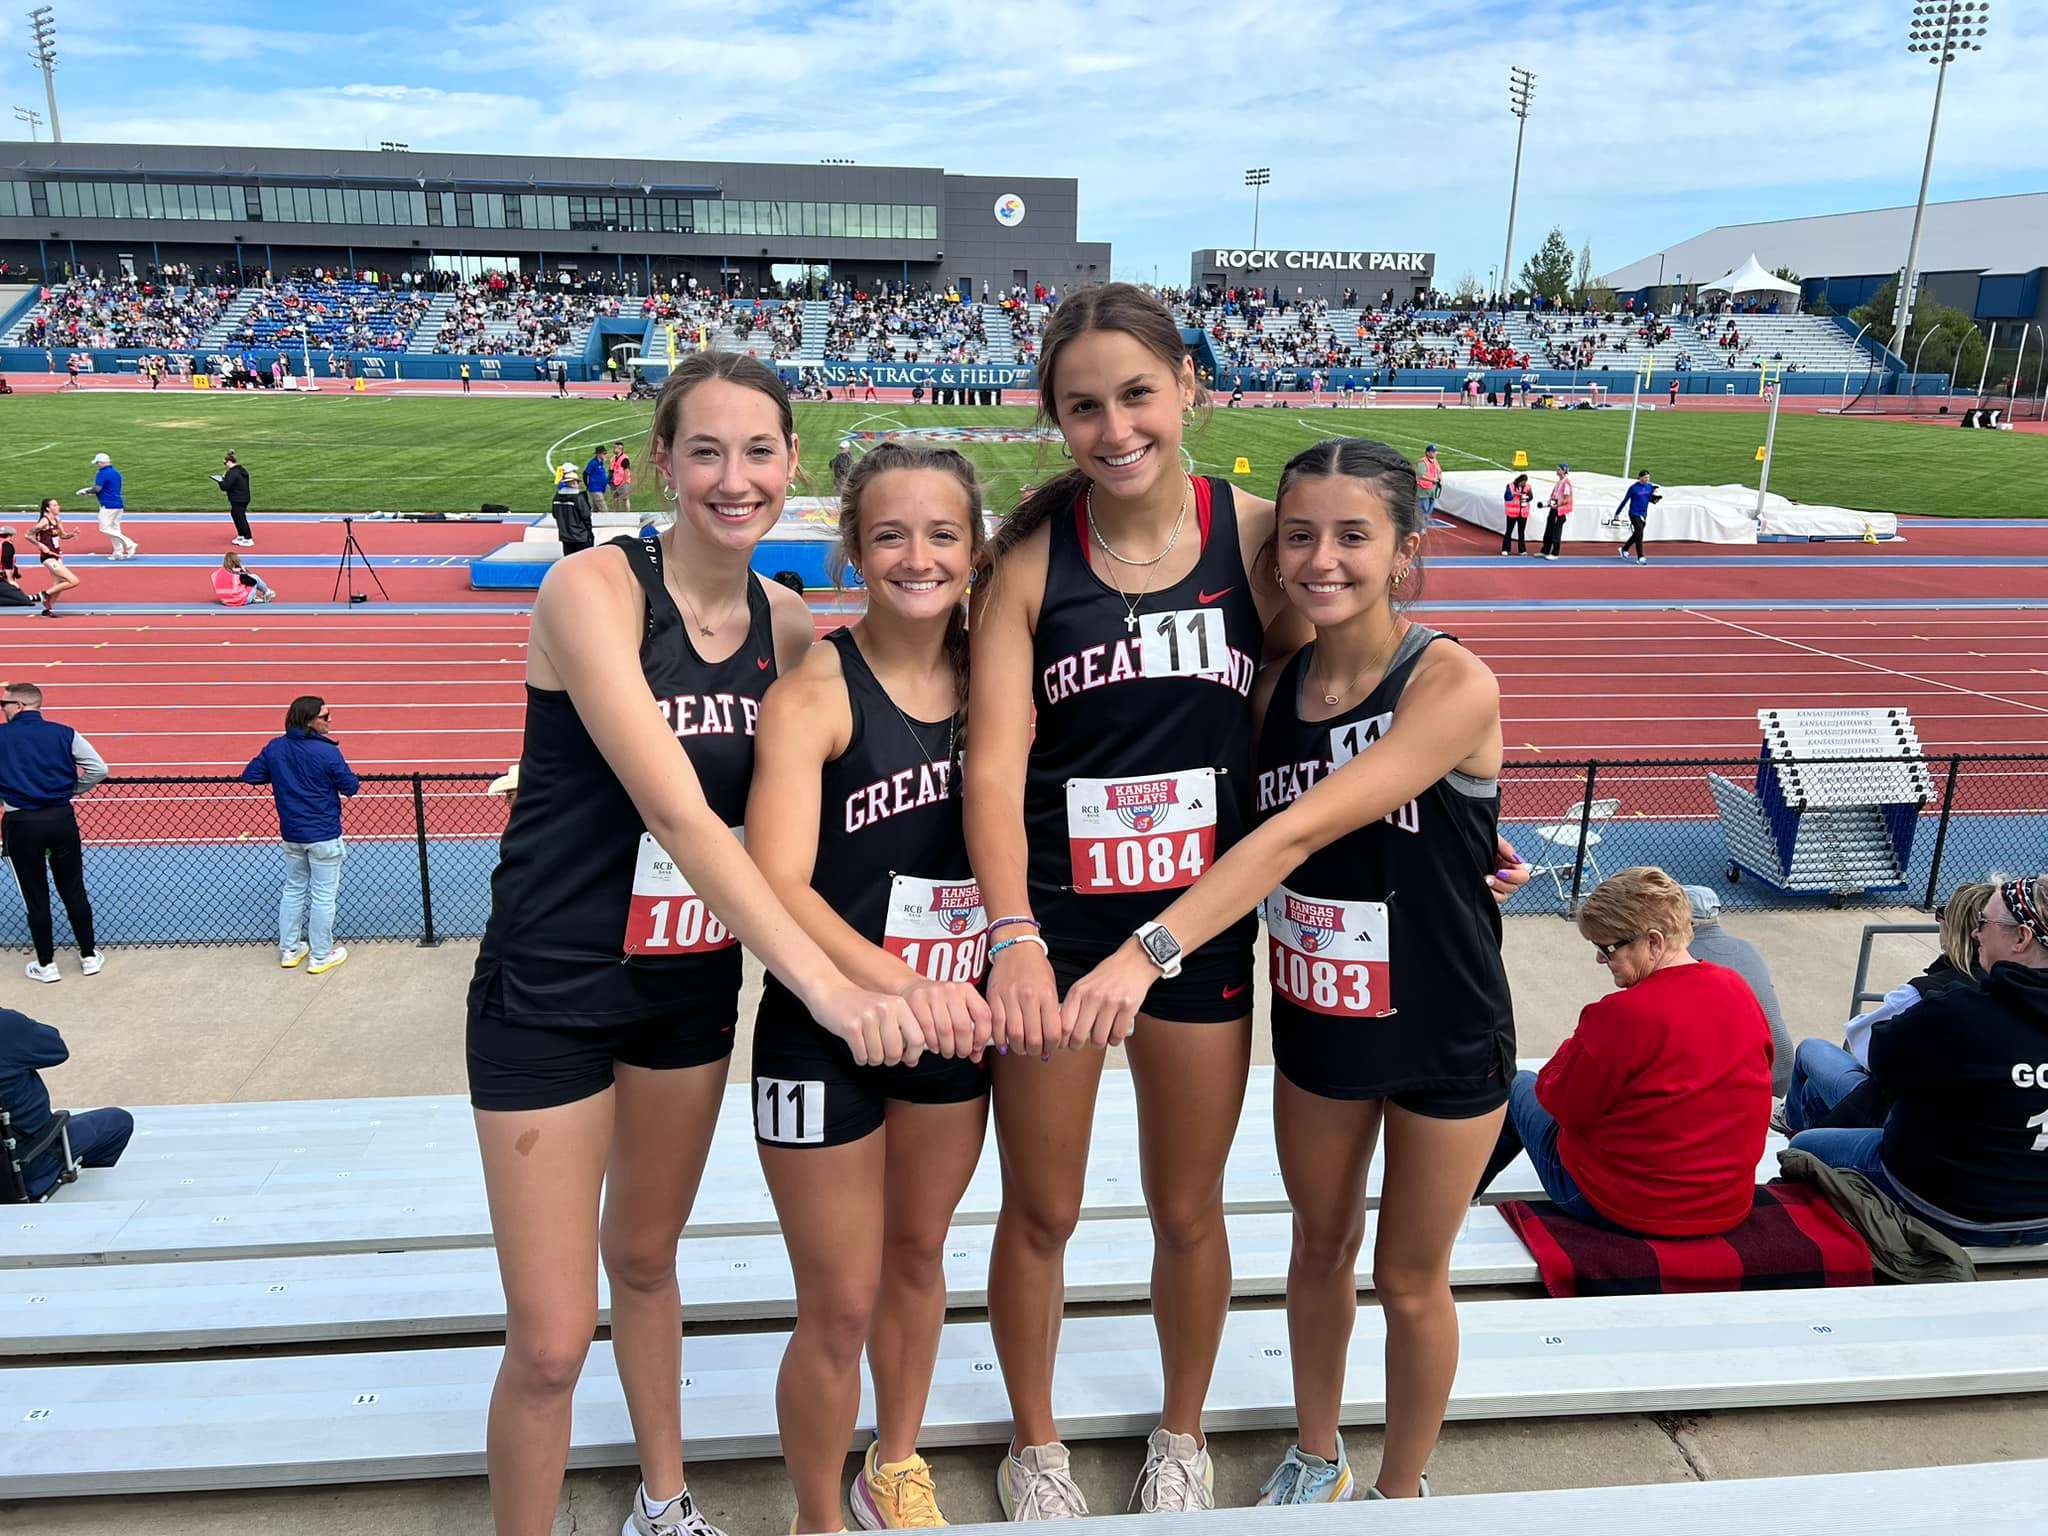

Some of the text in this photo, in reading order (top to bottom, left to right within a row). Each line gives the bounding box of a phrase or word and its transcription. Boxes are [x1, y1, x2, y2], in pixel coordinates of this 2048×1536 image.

[1215, 250, 1426, 271] ROCK CHALK PARK
[873, 367, 938, 384] TRACK
[941, 368, 956, 384] &
[961, 368, 1013, 385] FIELD
[1157, 612, 1210, 672] 11
[656, 692, 735, 737] EAT
[1115, 781, 1169, 796] KANSAS
[1257, 760, 1320, 813] REAT
[846, 760, 950, 834] GREAT
[1117, 791, 1168, 807] RELAYS
[1081, 805, 1100, 814] RCB
[653, 861, 673, 871] RCB
[1088, 832, 1205, 887] 1084
[903, 904, 923, 914] RCB
[1289, 898, 1335, 918] KANSAS
[645, 898, 736, 948] 108
[1291, 909, 1334, 928] RELAYS
[901, 932, 987, 982] 1080
[1276, 945, 1371, 1011] 1083
[766, 1082, 805, 1139] 11
[1546, 1336, 1562, 1345] 07
[974, 1363, 993, 1371] 09
[357, 1395, 376, 1404] 11
[29, 1409, 50, 1419] 12
